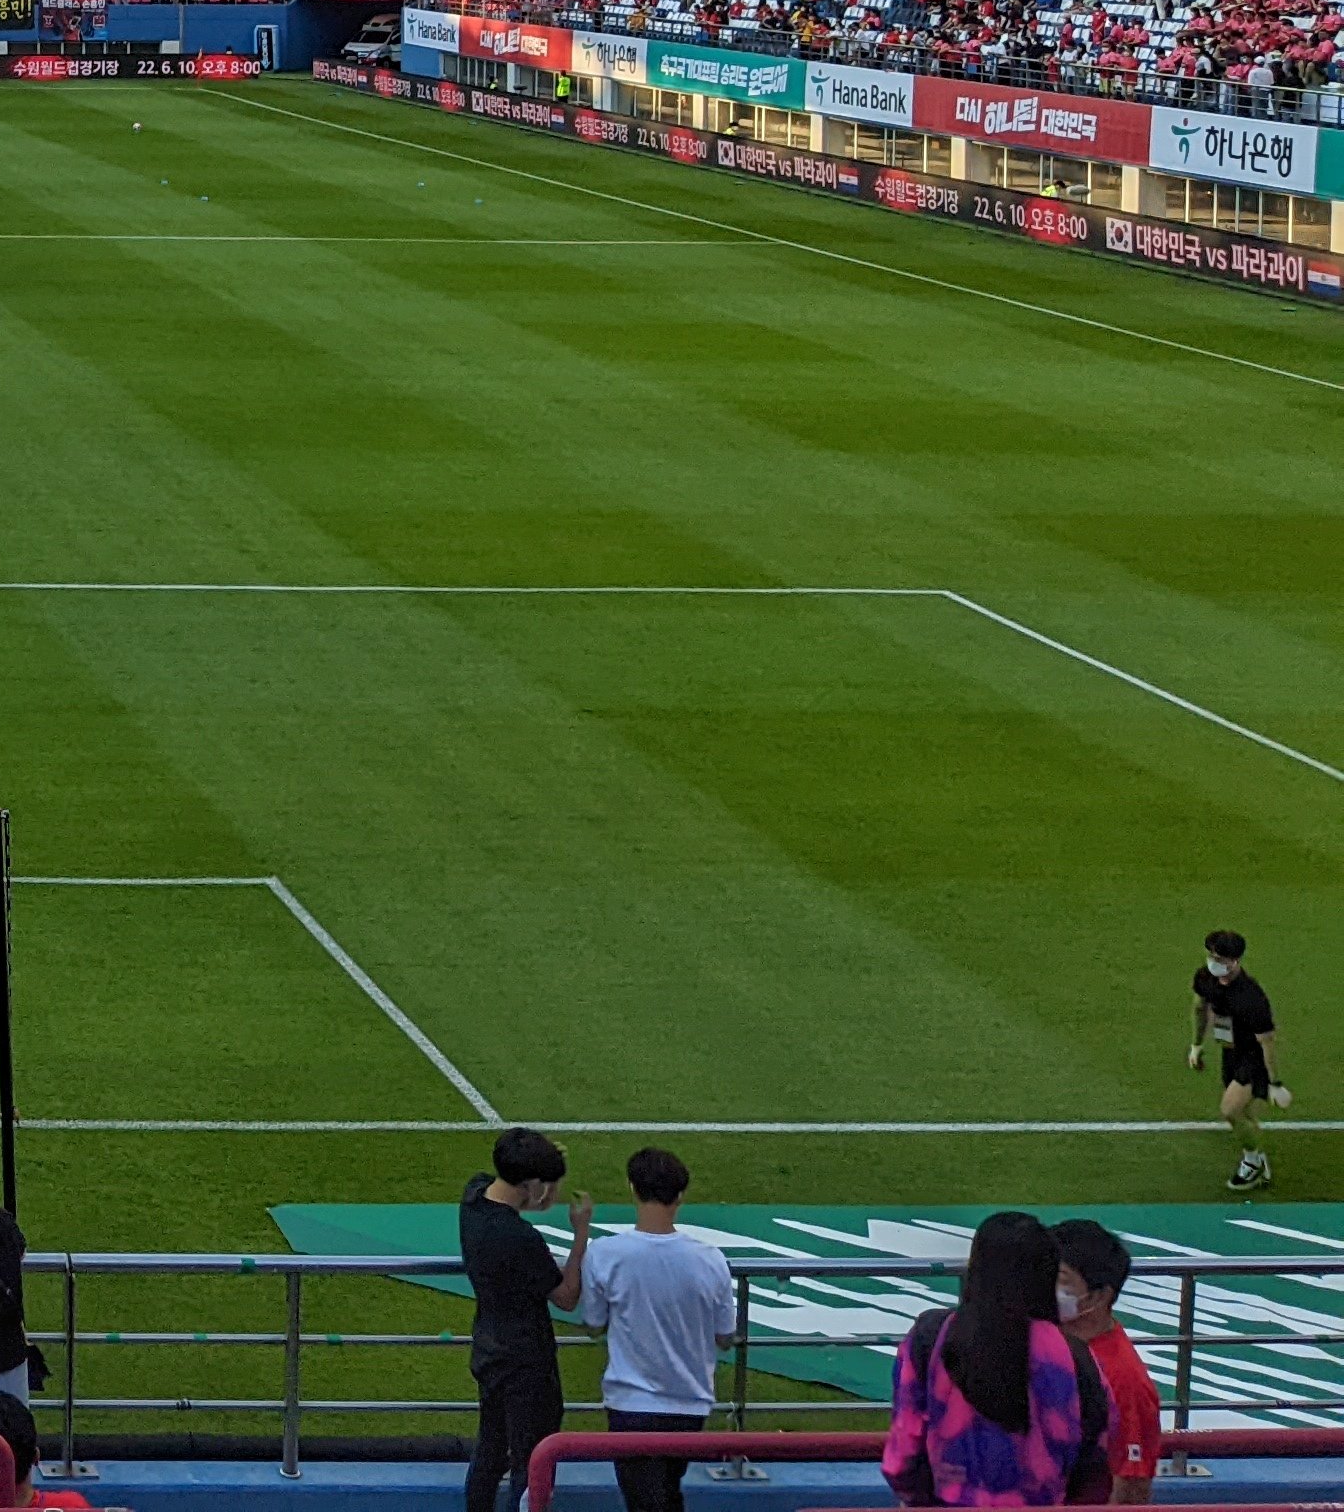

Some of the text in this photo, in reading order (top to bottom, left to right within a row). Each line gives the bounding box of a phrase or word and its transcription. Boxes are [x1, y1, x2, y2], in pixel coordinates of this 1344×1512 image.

[418, 20, 457, 44] Hana Bank
[14, 59, 119, 76] 수원월드컵경기장
[202, 60, 227, 76] 오후
[230, 60, 261, 75] 8:00
[596, 41, 637, 74] 하나은행
[832, 79, 907, 114] Hana Bank
[955, 96, 983, 123] 다시
[1040, 108, 1098, 142] 대한민국
[1204, 125, 1294, 178] 하나은행
[735, 144, 1087, 240] 대한민국 vs 파라과이 수원월드컵경기장 오후 8:00
[1136, 225, 1304, 291] 대한민국 vs 파라과이
